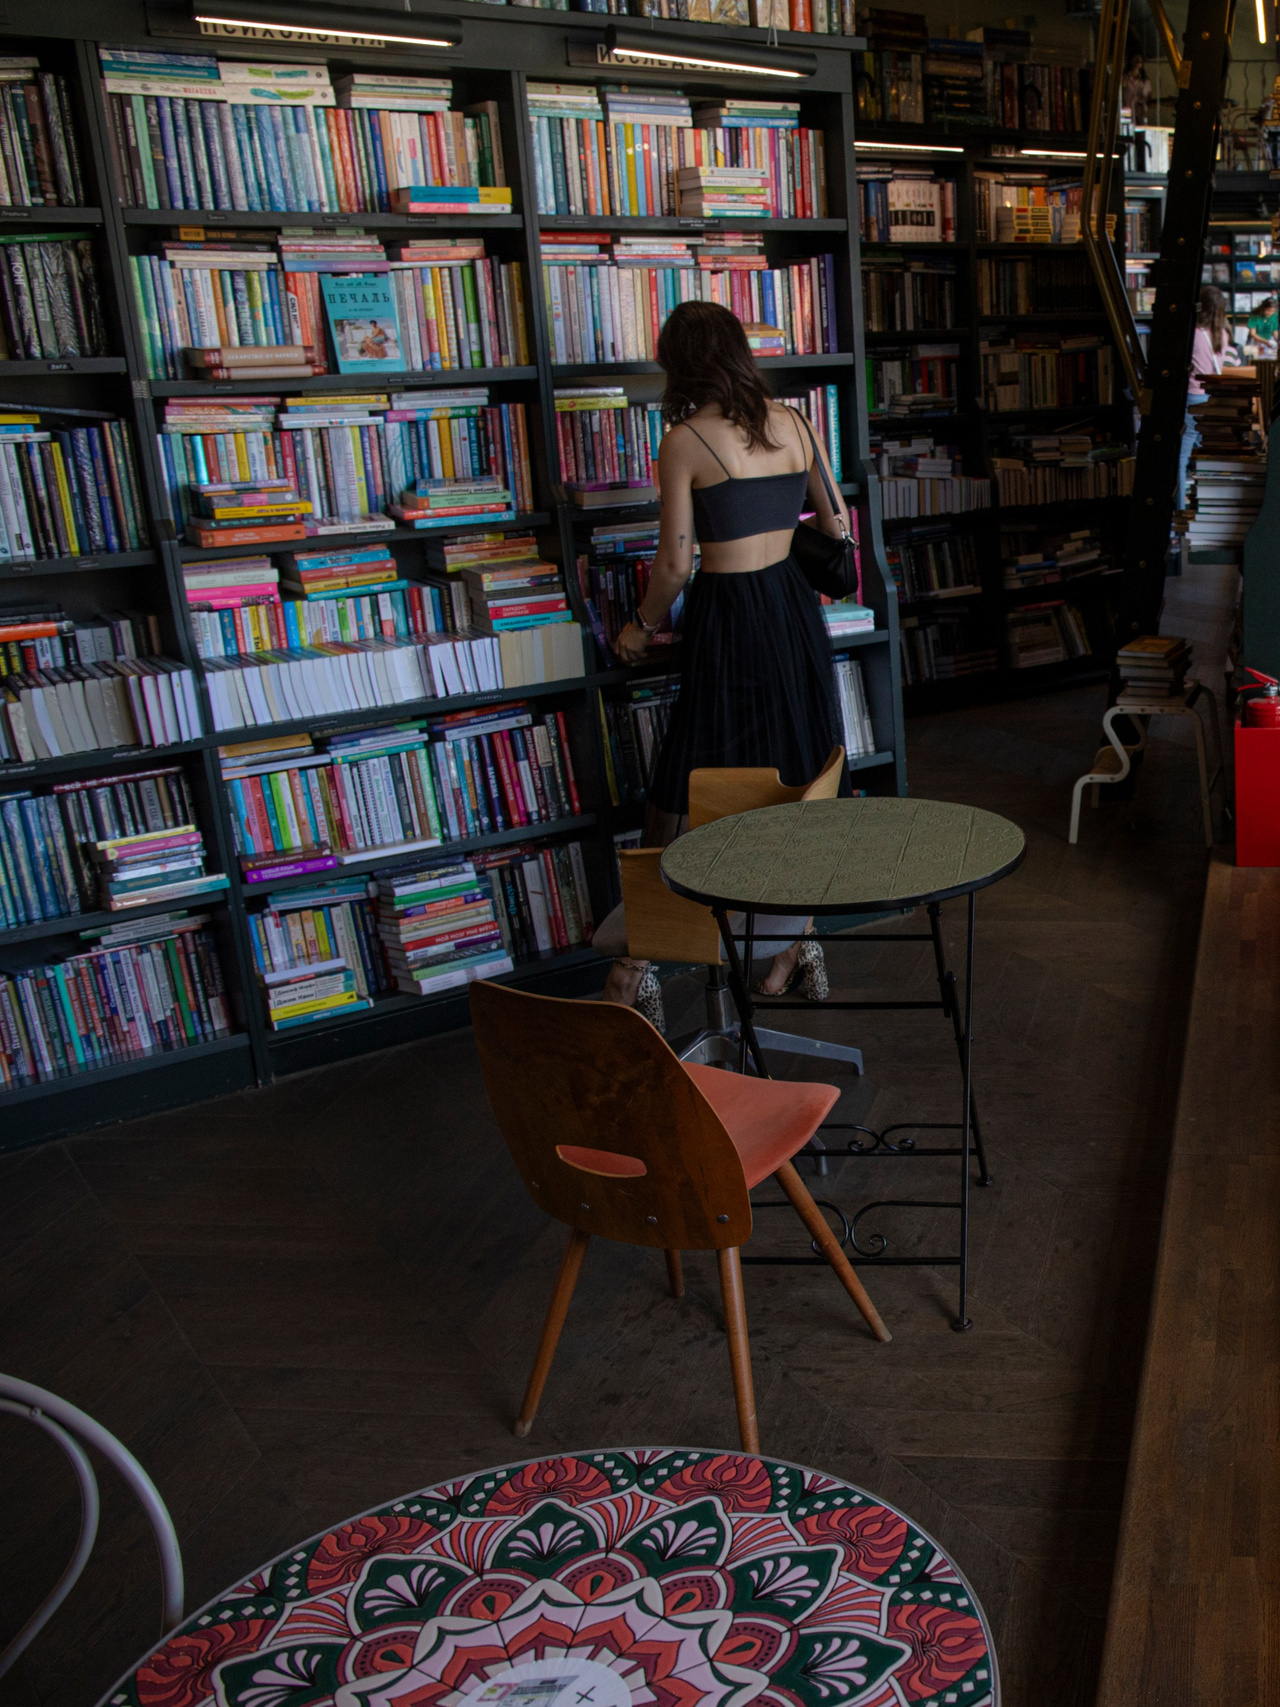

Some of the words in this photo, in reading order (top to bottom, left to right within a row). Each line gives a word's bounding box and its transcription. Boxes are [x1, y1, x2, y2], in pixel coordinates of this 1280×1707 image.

[328, 292, 390, 304] ПЕЧАЛЬ
[311, 787, 323, 817] ОСКАЛ
[435, 934, 449, 942] МОЙ
[449, 931, 465, 939] МОЗГ
